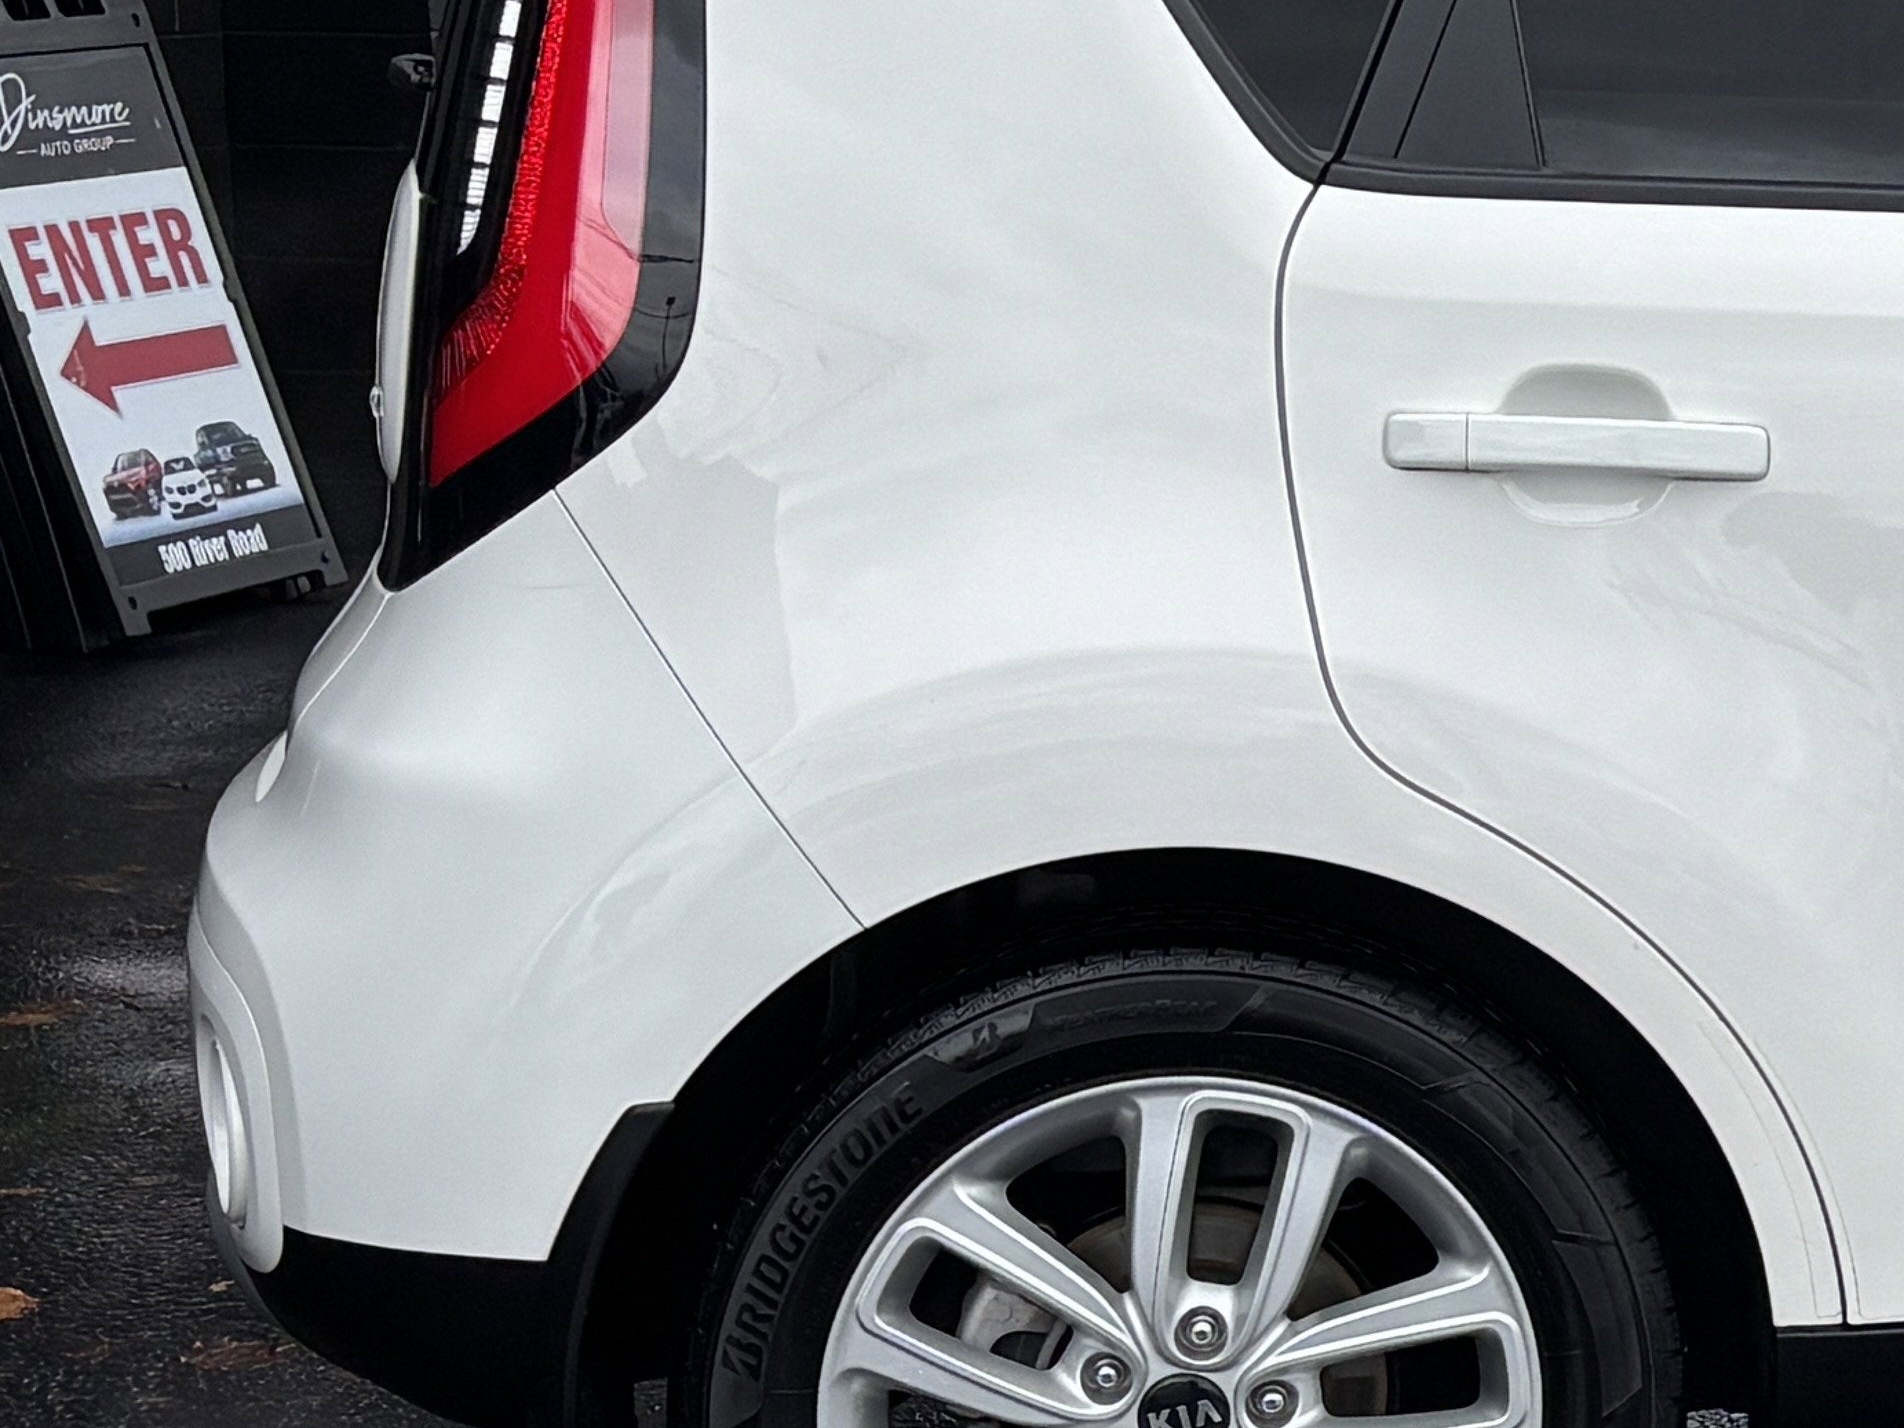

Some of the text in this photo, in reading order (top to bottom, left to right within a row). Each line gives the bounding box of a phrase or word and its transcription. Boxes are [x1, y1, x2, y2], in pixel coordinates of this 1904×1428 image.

[40, 135, 115, 157] AUTO GROUP
[8, 207, 210, 311] ENTER
[158, 523, 269, 574] 500 River Road
[721, 1080, 923, 1383] BRIDGESTONE
